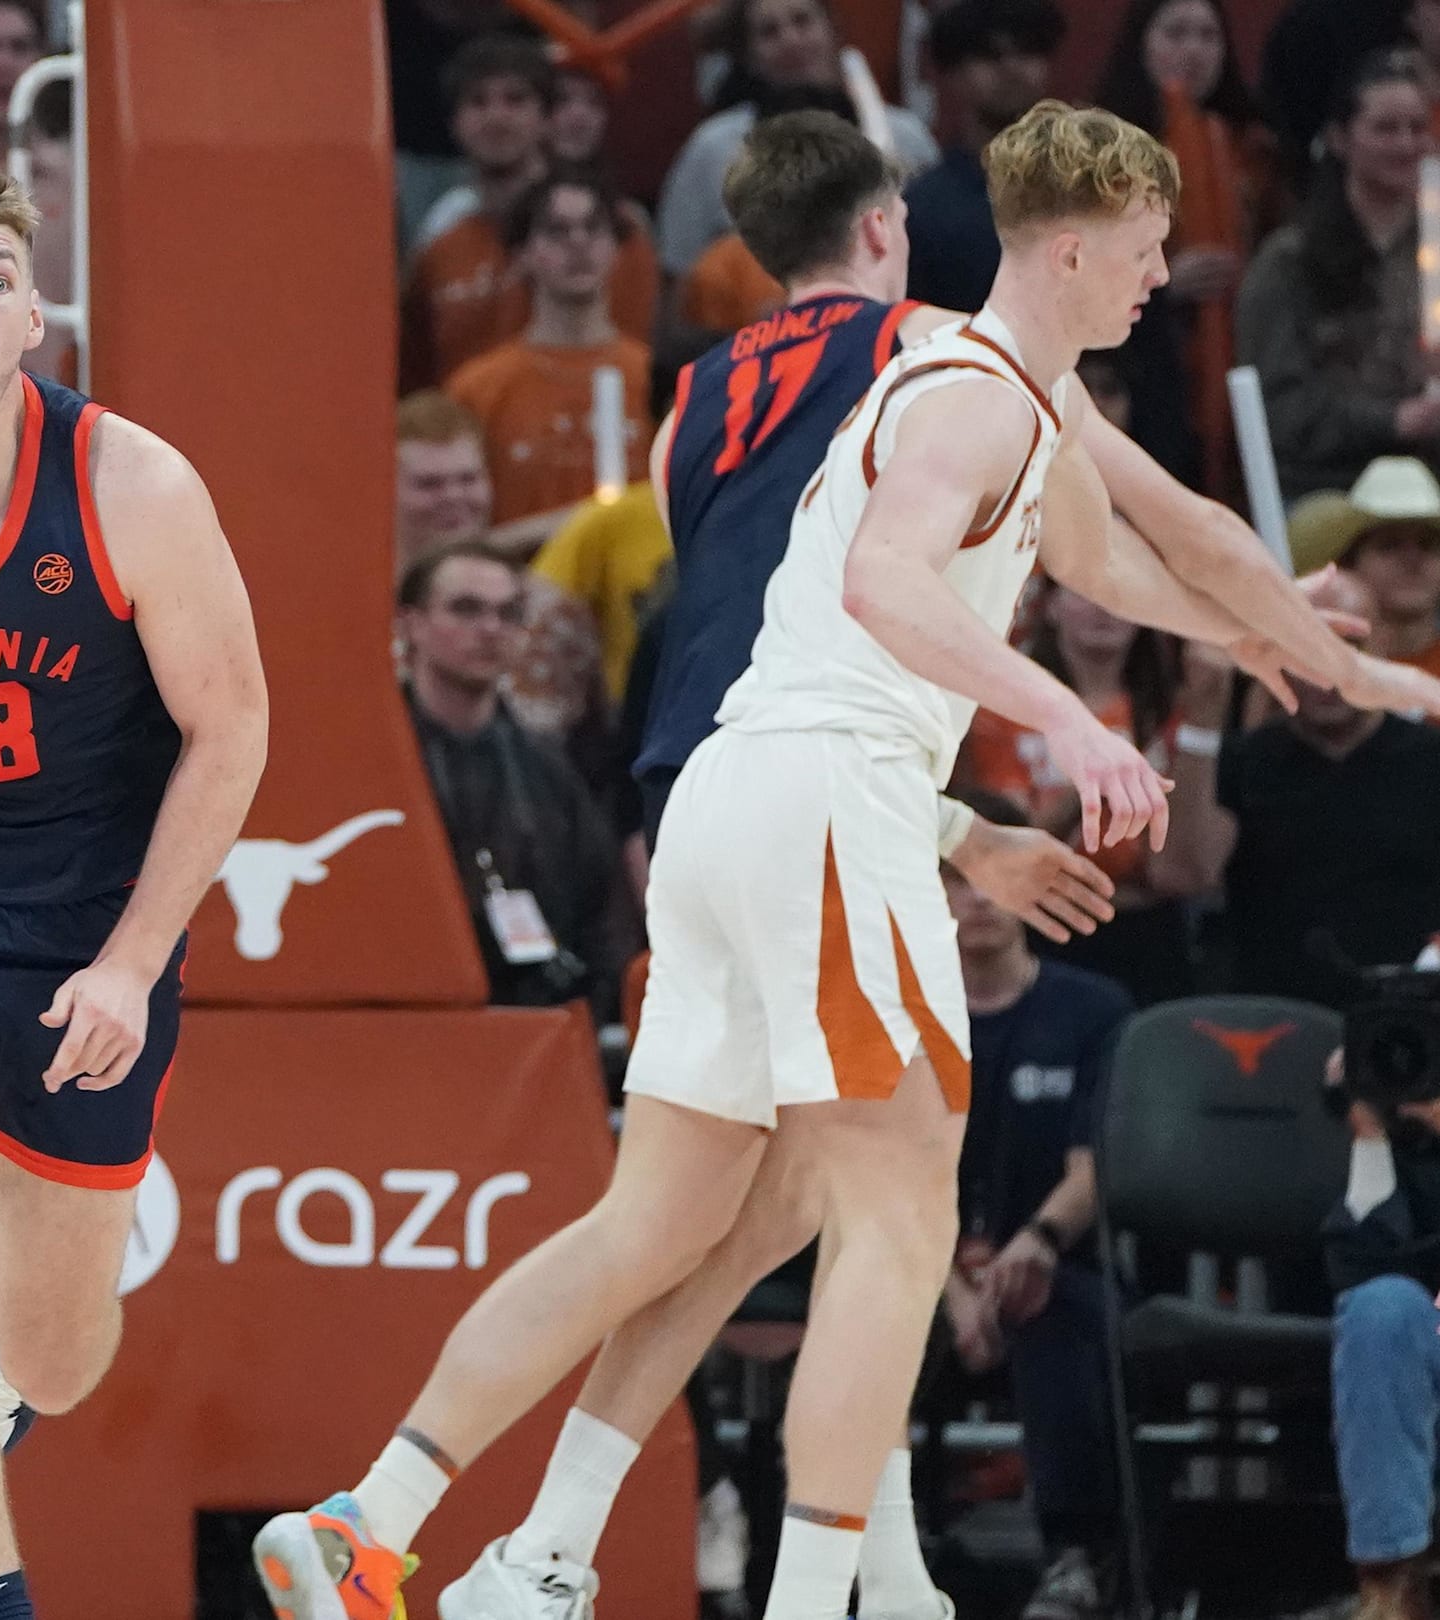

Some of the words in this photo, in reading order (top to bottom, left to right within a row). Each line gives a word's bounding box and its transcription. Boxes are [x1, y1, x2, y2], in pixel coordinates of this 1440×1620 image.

[713, 330, 832, 476] 17
[39, 564, 70, 579] ACC
[216, 1165, 531, 1270] razr
